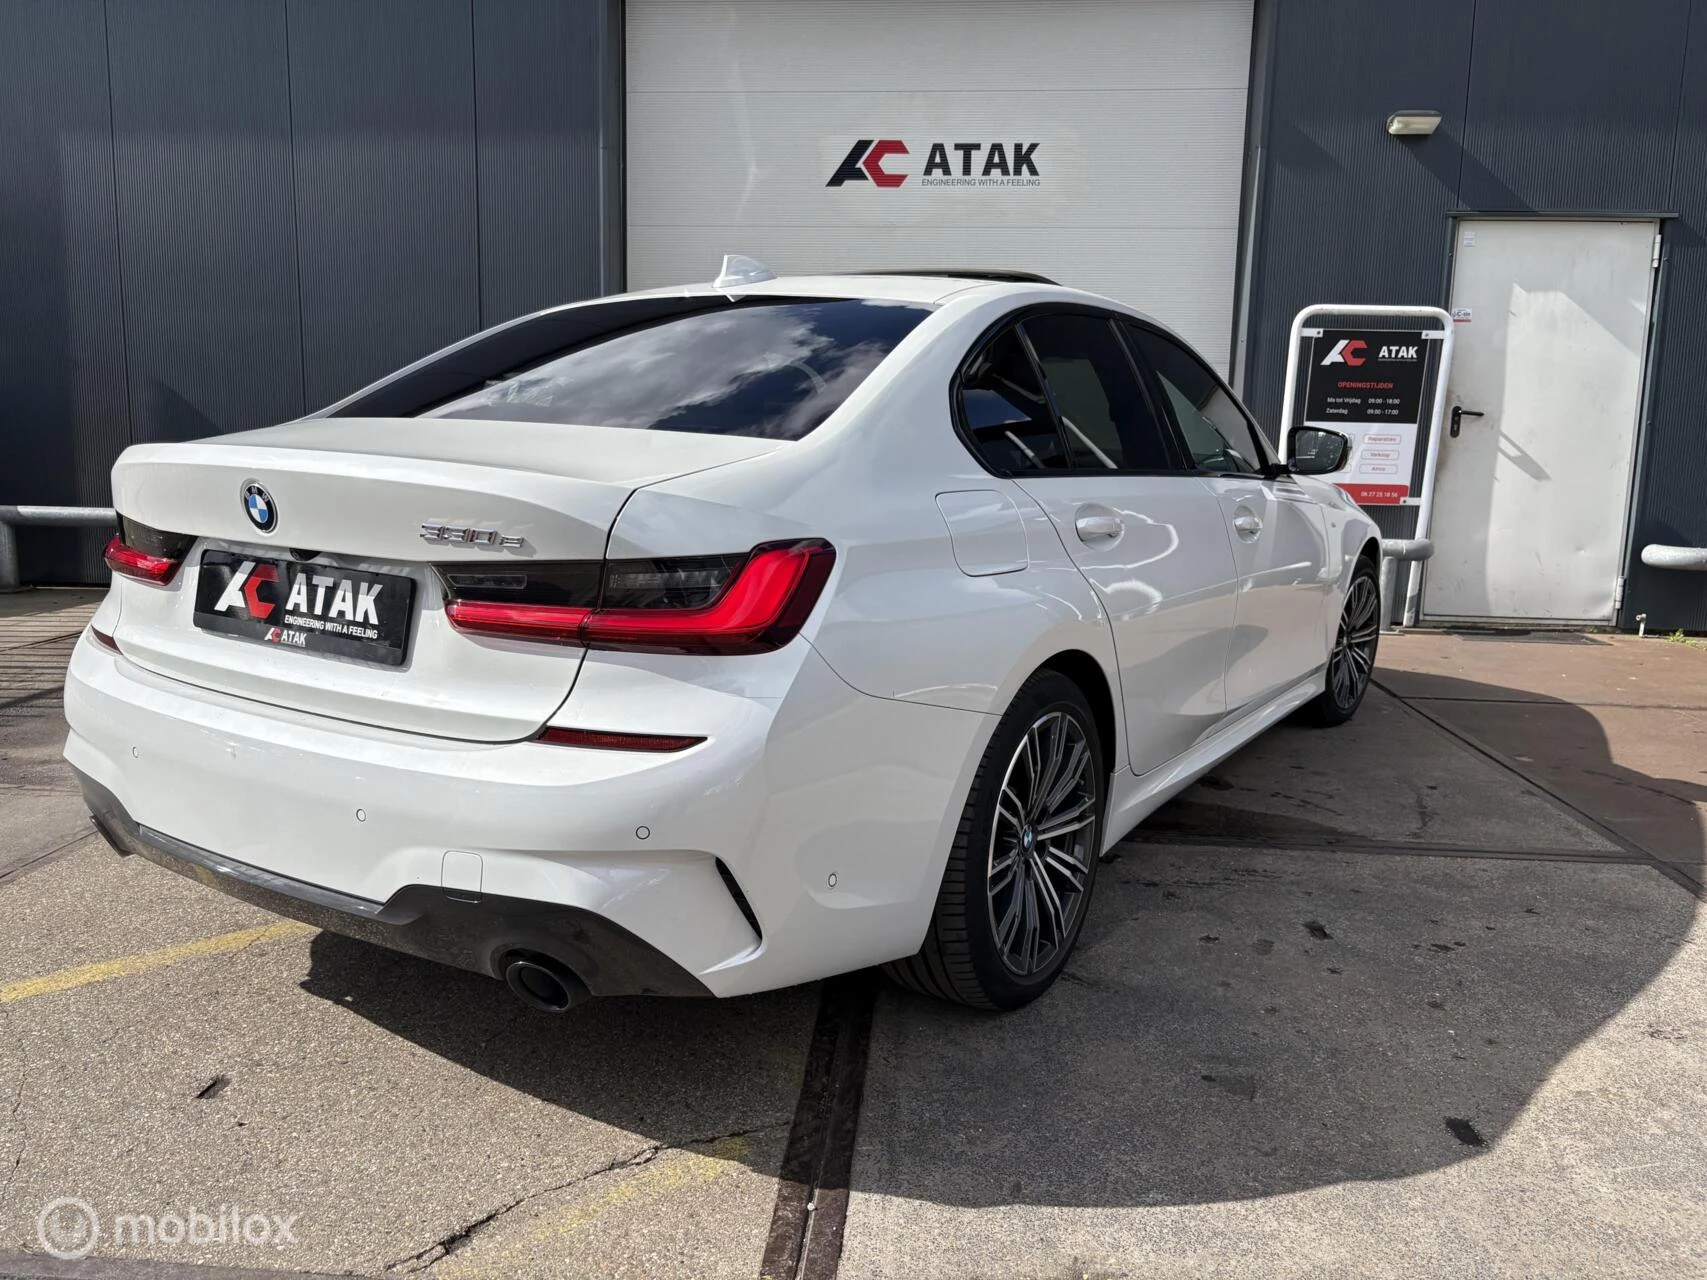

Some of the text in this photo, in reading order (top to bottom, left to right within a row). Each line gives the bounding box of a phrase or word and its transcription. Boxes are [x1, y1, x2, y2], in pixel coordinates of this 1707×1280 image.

[923, 143, 1041, 176] ATAK
[921, 178, 976, 187] ENGINEERING
[978, 178, 999, 187] WITH
[1006, 178, 1041, 187] FEELING
[1378, 345, 1418, 358] ATAK
[1337, 381, 1394, 389] OPENINGSTIJDEN
[420, 523, 524, 548] 330e
[285, 573, 383, 625] ATAK
[281, 627, 308, 645] ATAK
[284, 614, 378, 640] ENGINEERING WITH A FEELING
